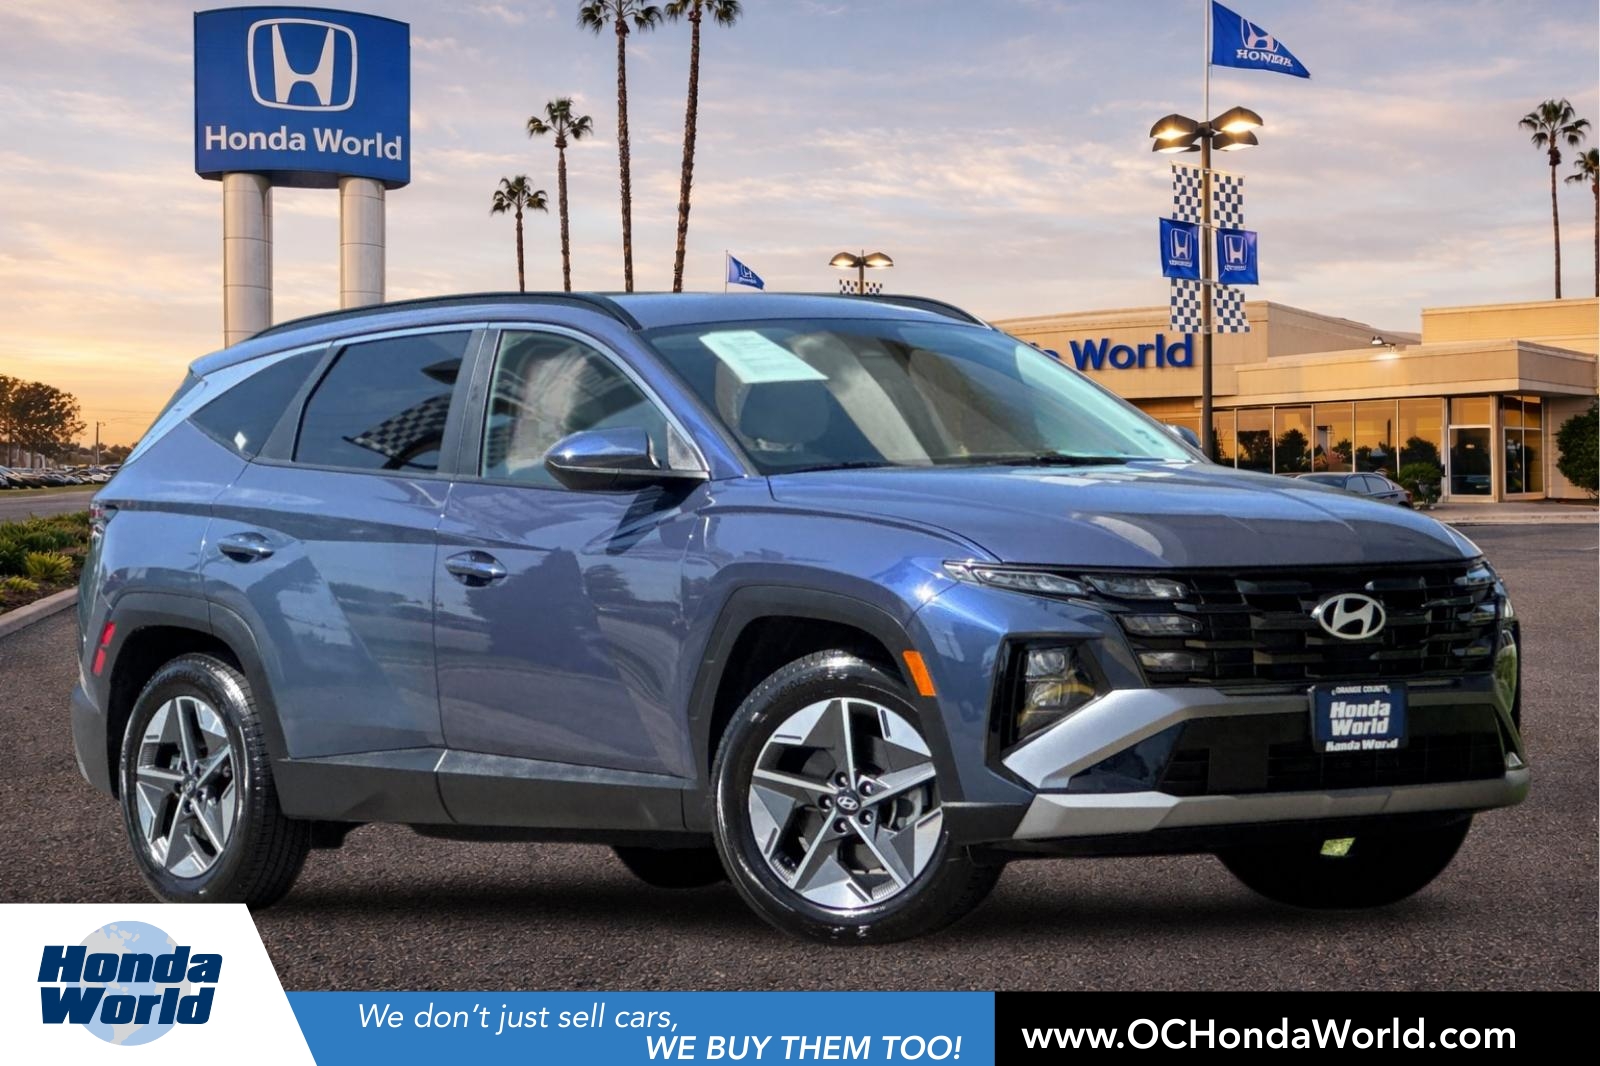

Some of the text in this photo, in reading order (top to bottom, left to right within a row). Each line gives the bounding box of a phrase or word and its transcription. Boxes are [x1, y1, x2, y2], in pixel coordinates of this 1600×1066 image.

[205, 125, 402, 161] Honda World
[1069, 333, 1194, 371] World
[1329, 700, 1391, 719] Honda
[1331, 717, 1390, 736] World
